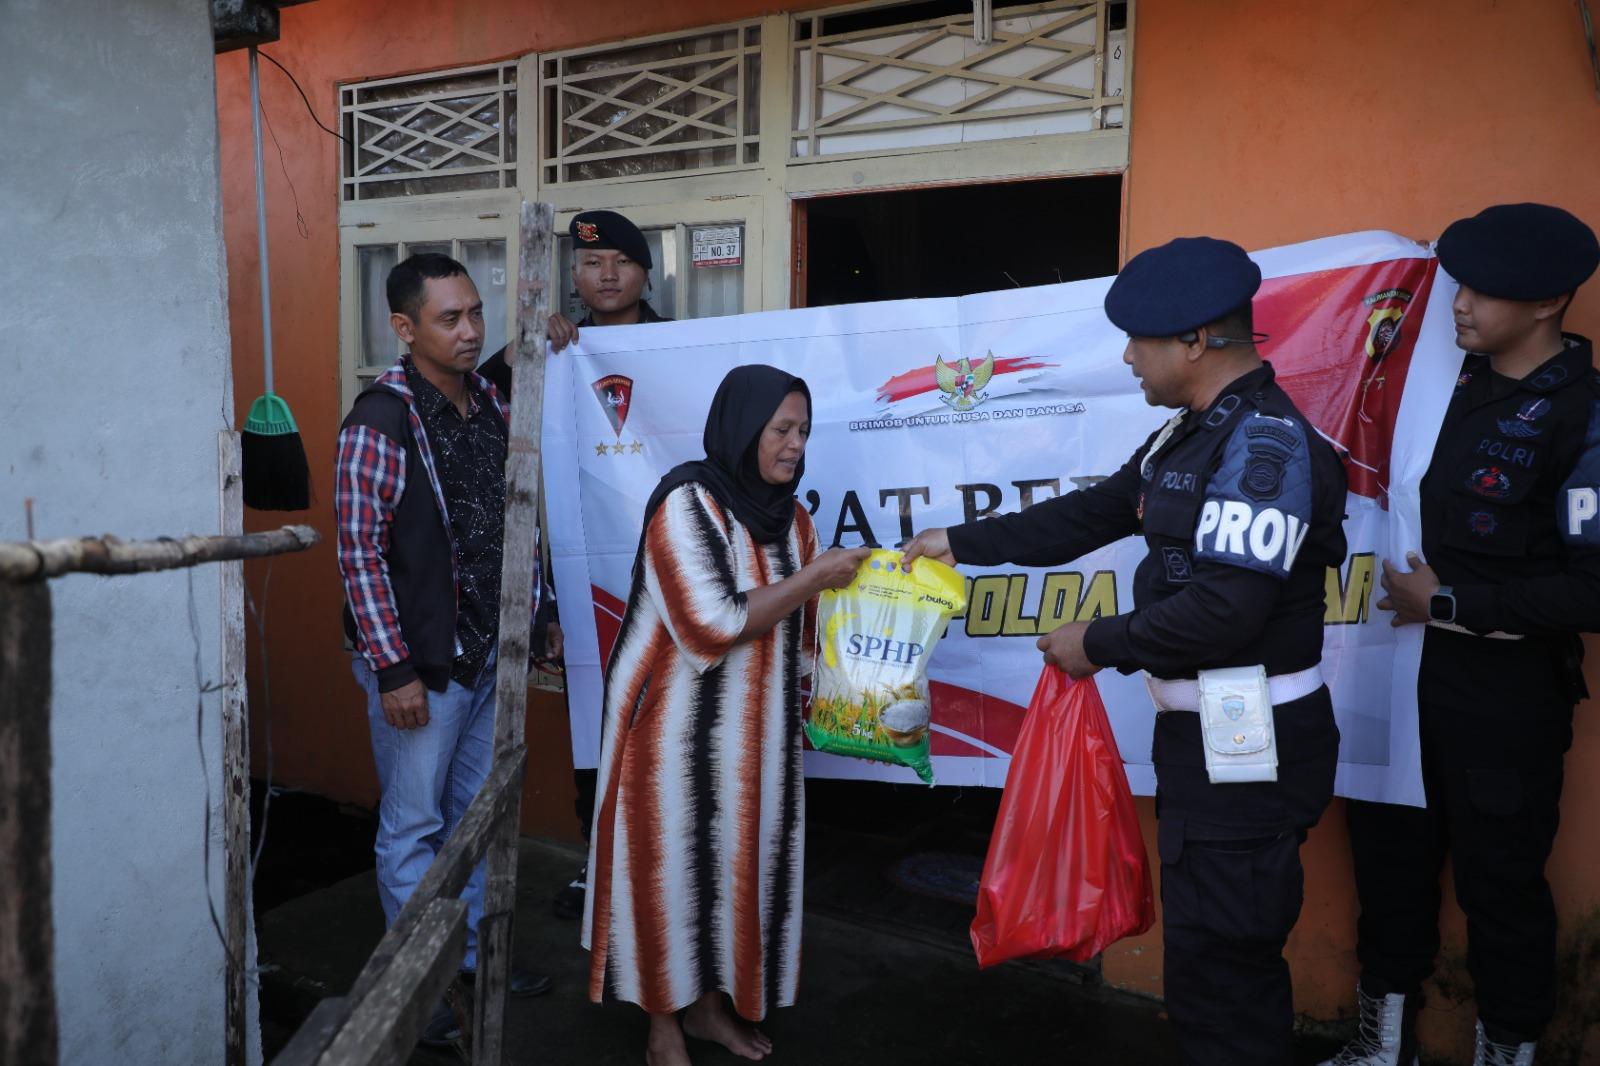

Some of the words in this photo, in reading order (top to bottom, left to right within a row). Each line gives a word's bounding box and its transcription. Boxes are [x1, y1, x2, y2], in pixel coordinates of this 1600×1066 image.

[711, 246, 724, 256] NO.
[727, 245, 736, 255] 37
[849, 418, 903, 431] BRIMOB
[906, 414, 950, 427] UNTUK
[952, 411, 991, 423] NUSA
[993, 408, 1023, 420] DAN
[1026, 402, 1087, 417] BANGSA
[1477, 439, 1536, 468] POLRI
[1160, 471, 1197, 492] POLRI
[1567, 487, 1600, 535] P
[1196, 500, 1310, 572] PROV
[925, 594, 954, 610] bulog
[941, 570, 1119, 638] OLDA
[846, 633, 924, 665] SPHP
[852, 724, 861, 736] 5
